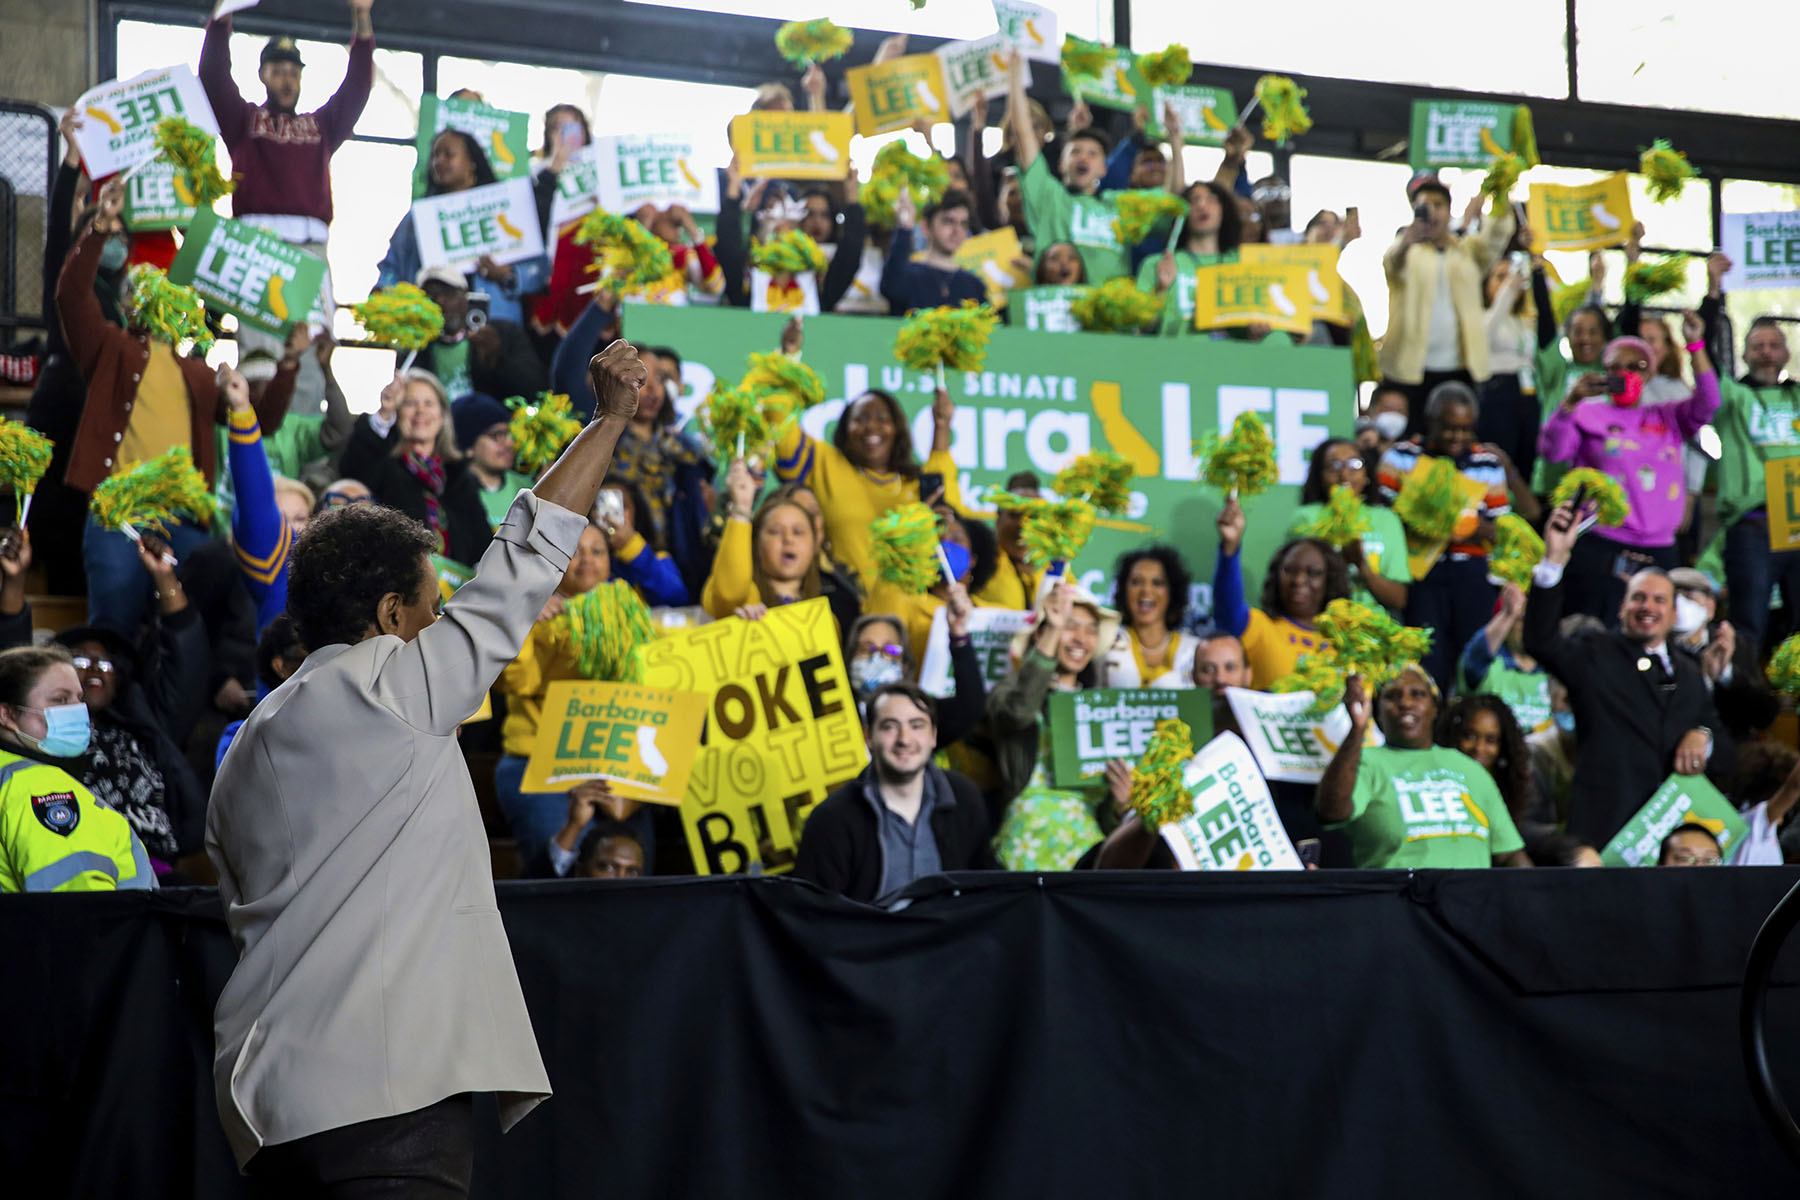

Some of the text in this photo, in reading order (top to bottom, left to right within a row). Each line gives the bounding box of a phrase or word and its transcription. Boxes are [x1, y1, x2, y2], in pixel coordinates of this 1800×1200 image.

[871, 83, 922, 117] LEE
[754, 132, 811, 153] LEE
[1427, 126, 1480, 152] LEE
[619, 158, 676, 187] LEE
[131, 176, 175, 208] LEE
[440, 215, 498, 251] LEE
[1546, 210, 1595, 233] LEE
[210, 226, 297, 281] Barbara
[196, 247, 271, 305] LEE
[1216, 285, 1268, 308] LEE
[963, 371, 1078, 402] SENATE
[1161, 381, 1329, 487] LEE
[645, 600, 828, 692] STAY
[566, 698, 669, 726] Barbara
[701, 652, 843, 746] OKE
[1075, 699, 1179, 722] Barbara
[554, 720, 638, 763] LEE
[1076, 720, 1156, 760] LEE
[1261, 724, 1322, 757] LEE
[552, 763, 662, 785] speaks for me
[687, 714, 859, 808] VOTE
[1188, 774, 1248, 868] LEE
[1217, 761, 1273, 867] Barbara
[1398, 791, 1469, 823] LEE
[1620, 792, 1693, 867] Barbara
